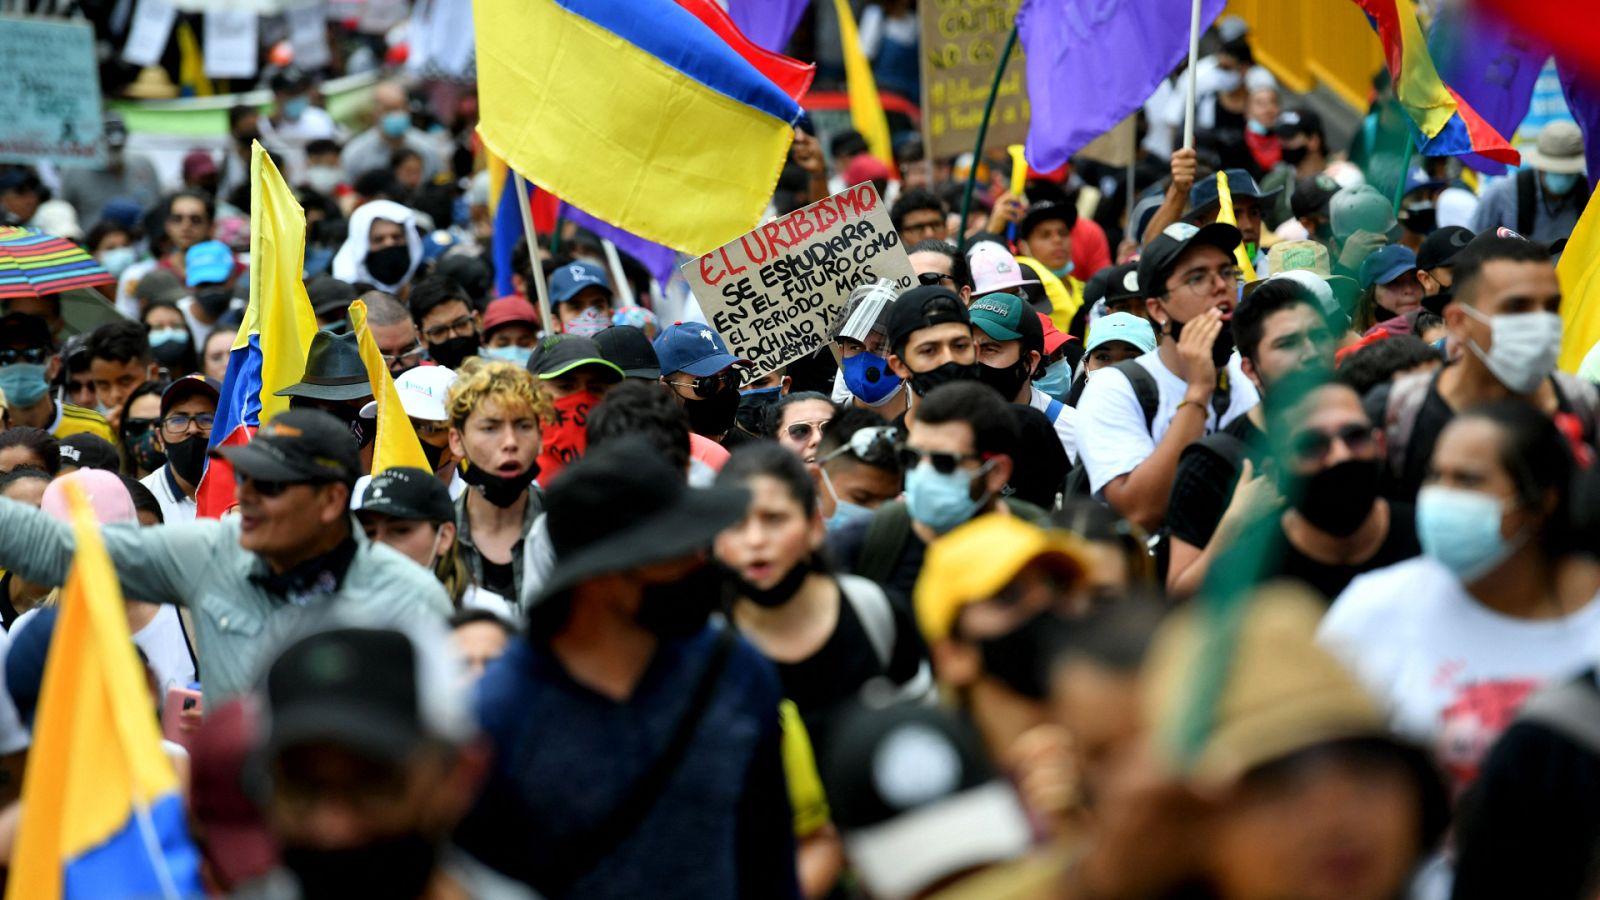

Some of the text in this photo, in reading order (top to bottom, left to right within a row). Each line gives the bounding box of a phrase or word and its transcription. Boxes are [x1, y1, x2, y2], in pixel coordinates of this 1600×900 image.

[700, 185, 878, 286] EL URIBISMO
[713, 305, 749, 334] EN
[751, 293, 779, 314] EL
[781, 257, 851, 302] FUTURO
[853, 230, 898, 264] COMO
[722, 277, 757, 306] SE
[729, 327, 750, 345] EL
[749, 292, 823, 336] PERIODO
[835, 264, 878, 295] MÁS
